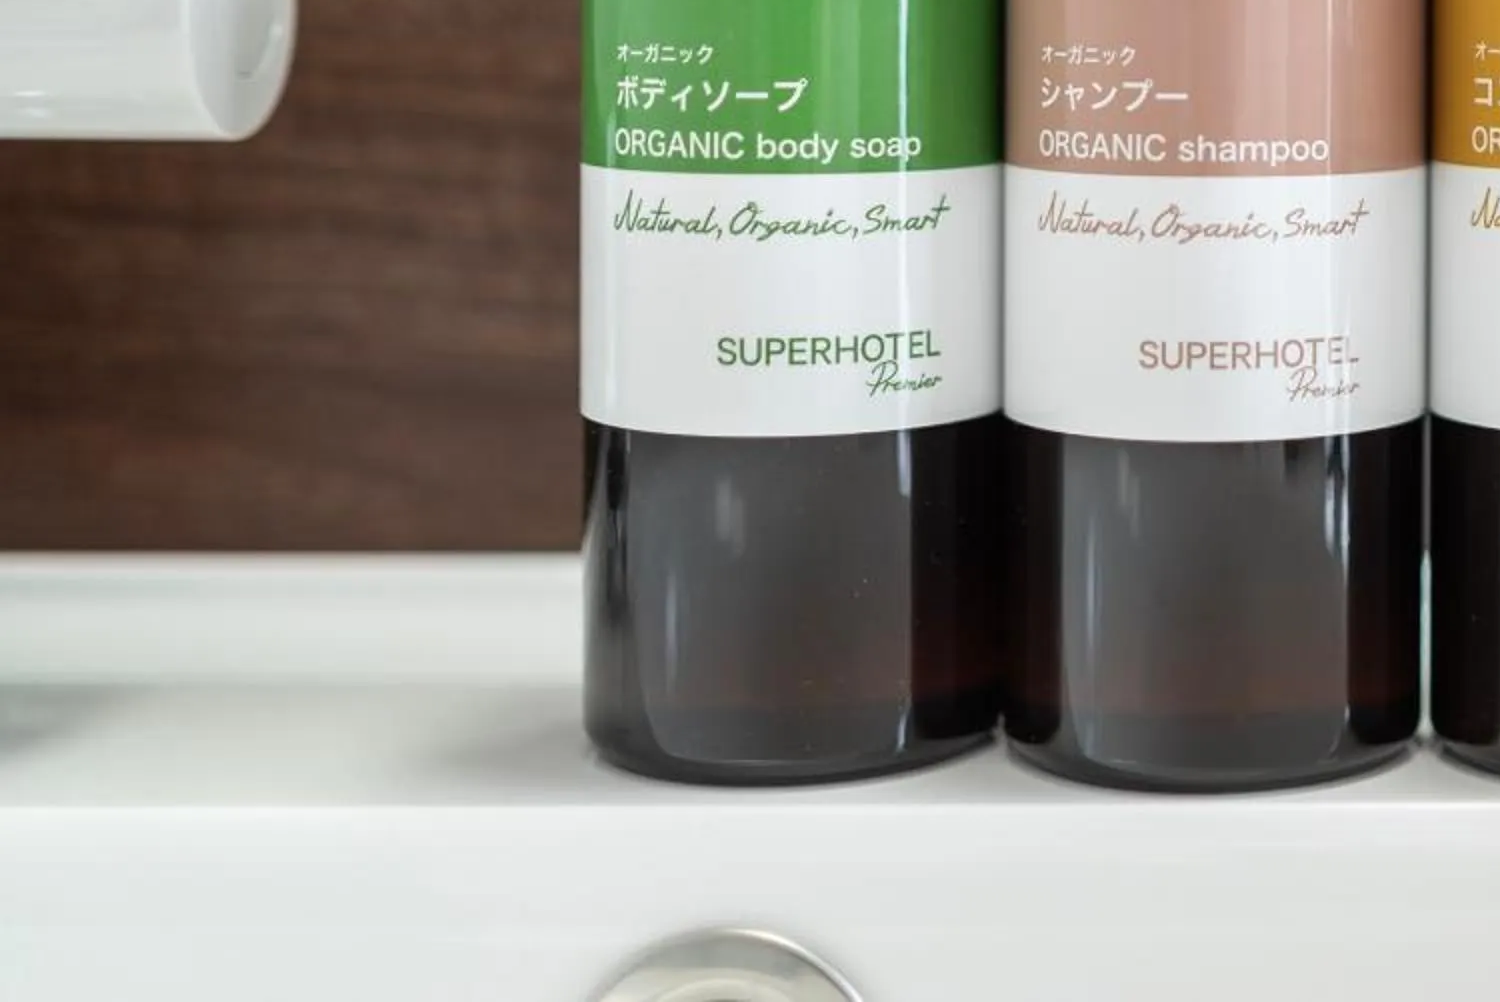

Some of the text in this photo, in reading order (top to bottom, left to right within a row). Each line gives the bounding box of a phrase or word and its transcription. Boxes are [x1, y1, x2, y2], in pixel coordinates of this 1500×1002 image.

[617, 43, 714, 65] オーガニック
[1041, 45, 1136, 65] オーガニック
[616, 74, 808, 112] ボディソープ
[1040, 77, 1189, 111] シャンプー
[615, 128, 922, 165] ORGANIC body soap
[1039, 129, 1330, 166] ORGANIC shampoo
[614, 189, 951, 242] Natural, Organic, Smart
[1038, 190, 1370, 244] Natural, Organic, Smart
[717, 329, 941, 366] SUPERHOTEL
[1139, 336, 1360, 370] SUPERHOTEL
[865, 359, 943, 397] Premier
